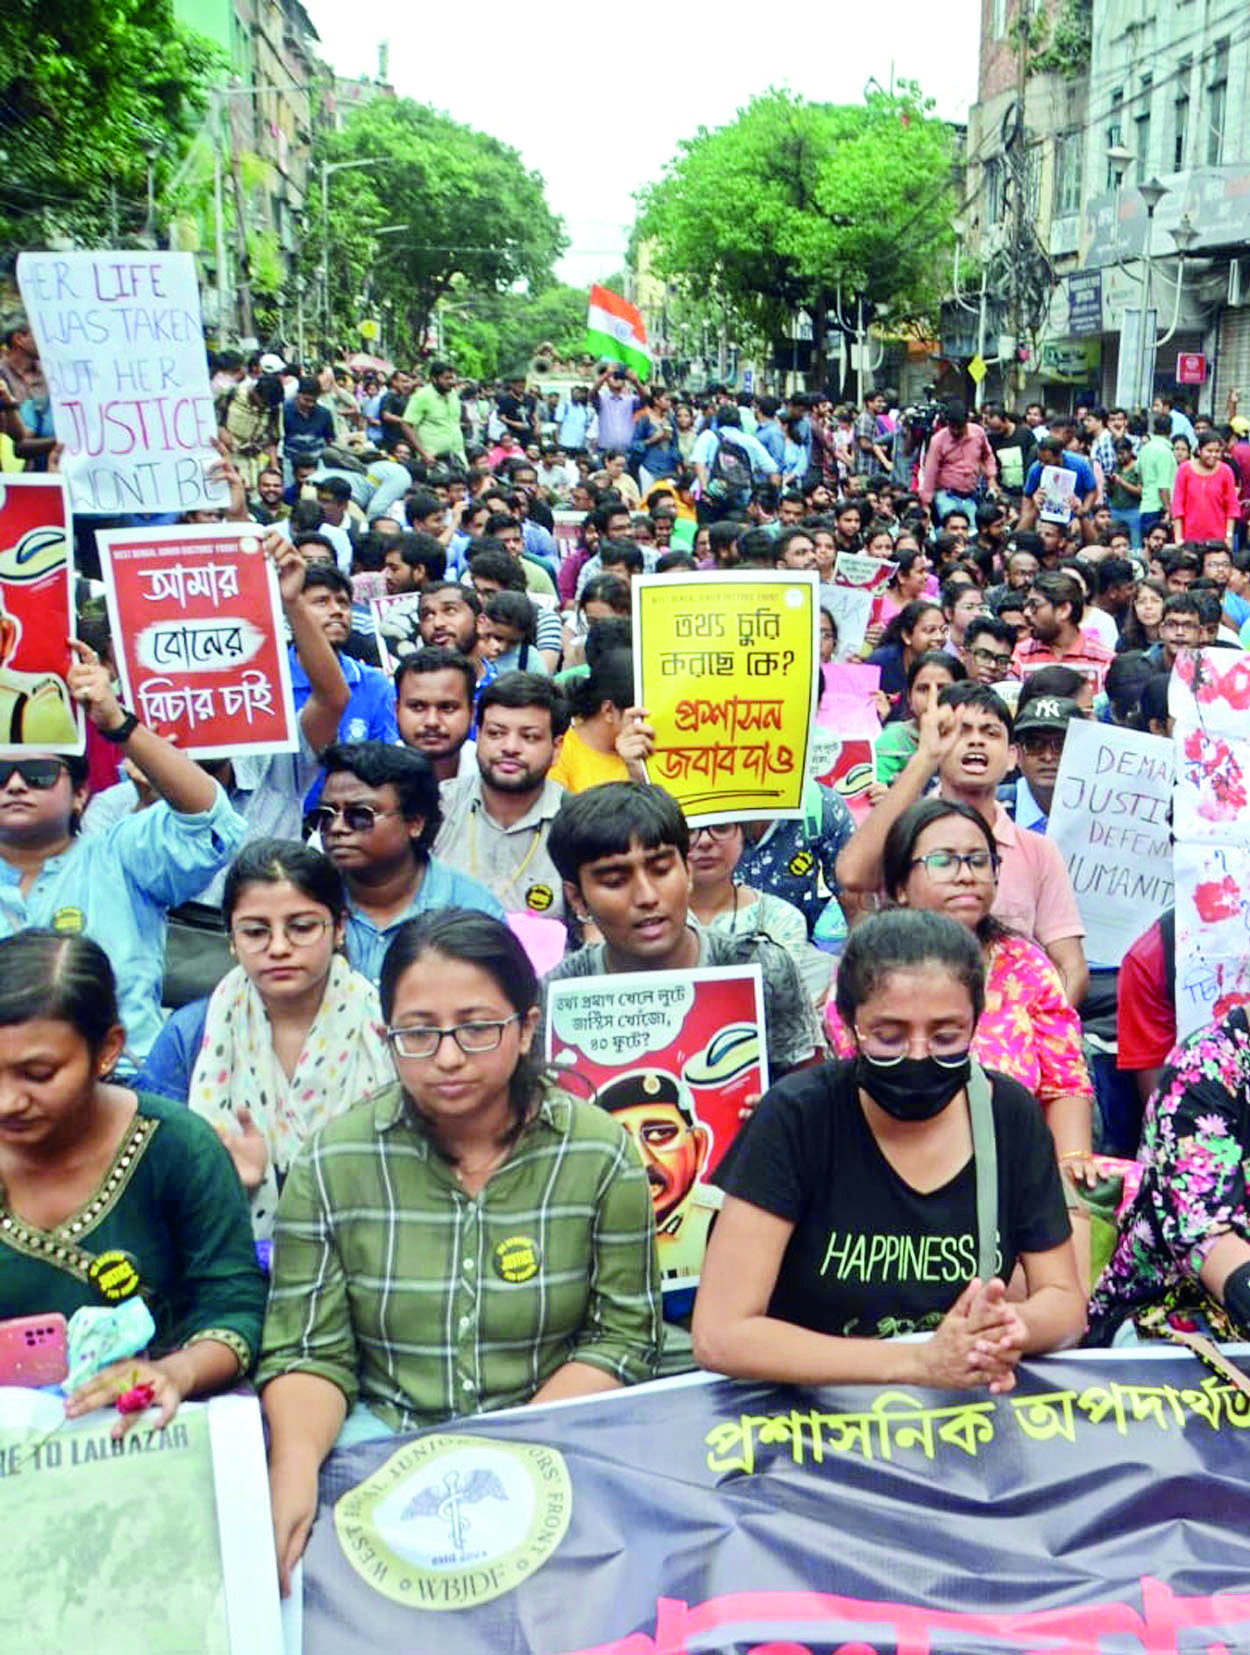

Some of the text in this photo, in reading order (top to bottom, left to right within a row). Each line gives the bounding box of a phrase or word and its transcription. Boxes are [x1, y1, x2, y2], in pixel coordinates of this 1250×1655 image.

[93, 263, 165, 302] LIFE
[38, 307, 208, 344] WAS TAKEN
[114, 358, 183, 393] HER
[60, 396, 217, 457] JUSTICE
[138, 562, 240, 609] আমার
[154, 626, 244, 669] বোনের
[674, 608, 781, 647] তথ্য চুরি
[660, 650, 796, 678] করছে কে?
[137, 670, 276, 729] বিচার চাই
[674, 694, 785, 742] প্রশাসন
[653, 740, 738, 788] জবাব
[740, 740, 795, 785] দাও
[1062, 776, 1168, 825] JUSTI
[1089, 821, 1174, 860] DEFEN
[1067, 852, 1175, 908] UMANIT
[819, 1231, 978, 1282] HAPPINESS
[32, 1439, 63, 1471] TO
[71, 1423, 189, 1467] LALBAZAR
[704, 1390, 996, 1475] প্রশাসনিক
[344, 1522, 390, 1583] WEST
[390, 1437, 456, 1479] JUNIO
[530, 1491, 565, 1556] FRONT
